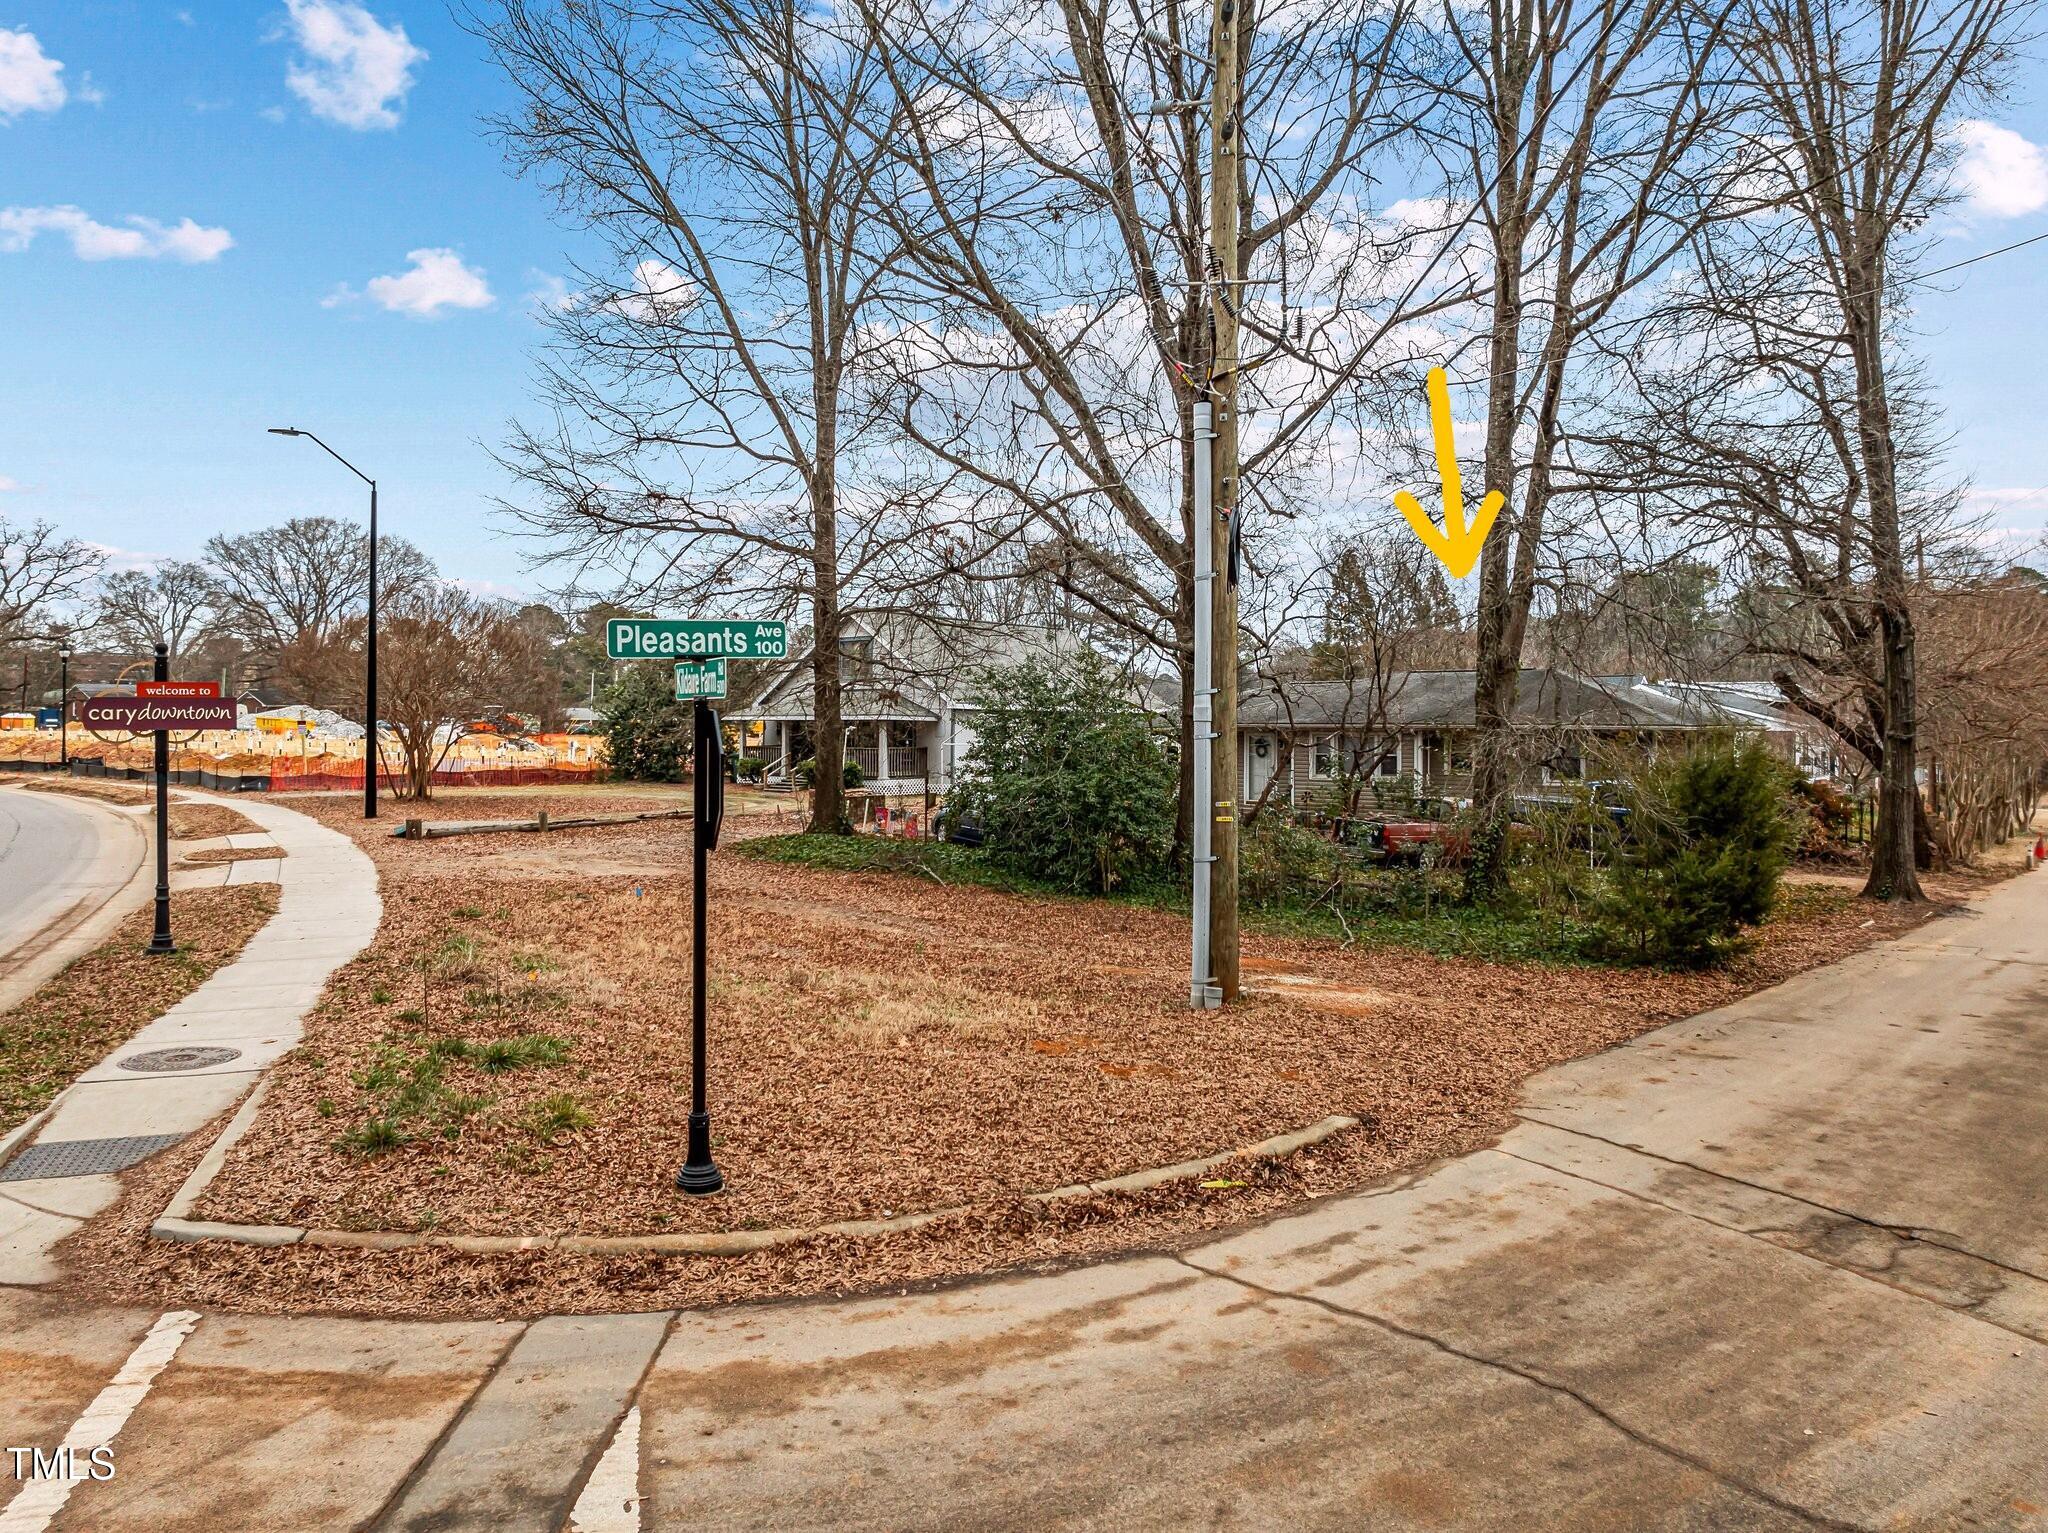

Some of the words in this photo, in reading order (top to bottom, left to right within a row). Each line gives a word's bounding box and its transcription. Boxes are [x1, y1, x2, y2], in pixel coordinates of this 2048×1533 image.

[616, 625, 748, 653] Pleasants
[755, 624, 782, 638] Ave
[755, 641, 783, 654] 100
[676, 667, 700, 694] Kildaire
[700, 665, 717, 693] Farm
[145, 685, 196, 696] welcome
[199, 686, 211, 696] to
